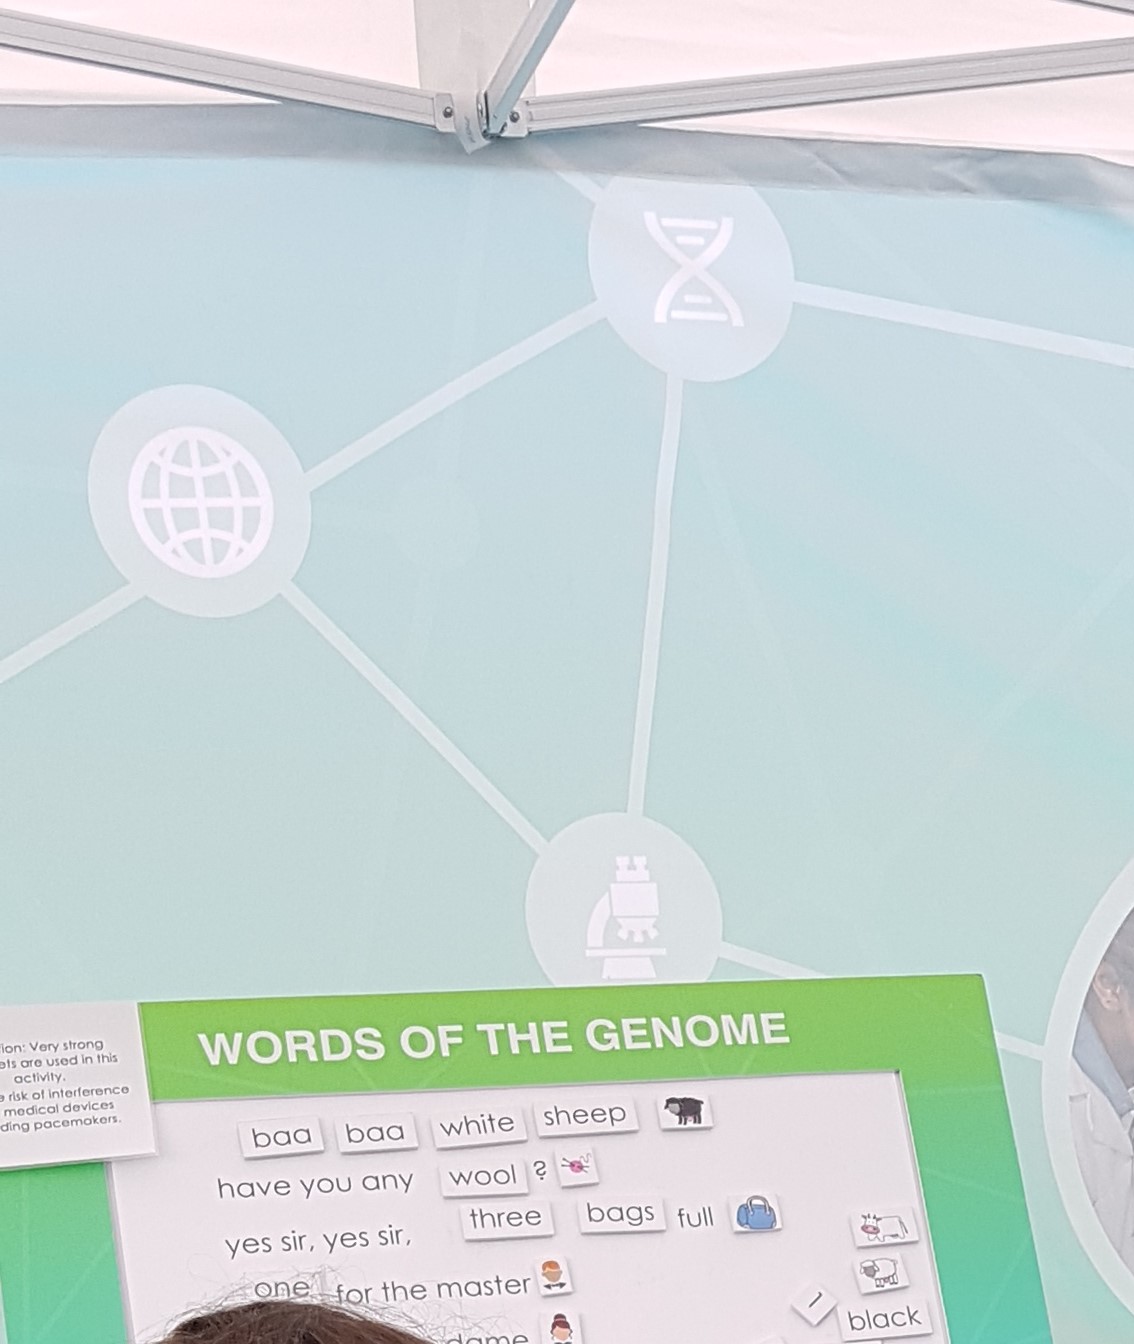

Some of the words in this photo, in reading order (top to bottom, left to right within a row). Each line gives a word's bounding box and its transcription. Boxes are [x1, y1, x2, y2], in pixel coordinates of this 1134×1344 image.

[29, 1042, 59, 1053] Very
[63, 1040, 104, 1051] strong
[197, 1031, 386, 1066] WORDS
[400, 1024, 465, 1059] OF
[476, 1020, 574, 1056] THE
[585, 1012, 790, 1052] GENOME
[20, 1059, 42, 1068] are
[46, 1055, 78, 1066] used
[81, 1054, 93, 1064] in
[97, 1052, 118, 1063] this
[14, 1072, 66, 1083] activity.
[8, 1091, 28, 1102] risk
[32, 1089, 45, 1100] of
[48, 1086, 129, 1098] interference
[4, 1104, 59, 1116] medical
[62, 1101, 114, 1113] devices
[34, 1115, 122, 1131] pacemakers.
[252, 1127, 312, 1149] baa
[344, 1122, 405, 1144] baa
[439, 1113, 515, 1137] white
[543, 1101, 627, 1128] sheep
[217, 1176, 291, 1199] have
[299, 1175, 352, 1200] you
[362, 1171, 414, 1196] any
[449, 1164, 517, 1187] wool
[225, 1235, 271, 1260] yes
[281, 1228, 314, 1253] sir,
[323, 1230, 370, 1255] yes
[379, 1224, 412, 1247] sir,
[469, 1206, 542, 1229] three
[587, 1200, 655, 1226] bags
[677, 1206, 714, 1228] full
[254, 1277, 310, 1299] one
[336, 1279, 373, 1305] for
[382, 1279, 427, 1302] the
[437, 1273, 531, 1299] master
[847, 1306, 923, 1331] black
